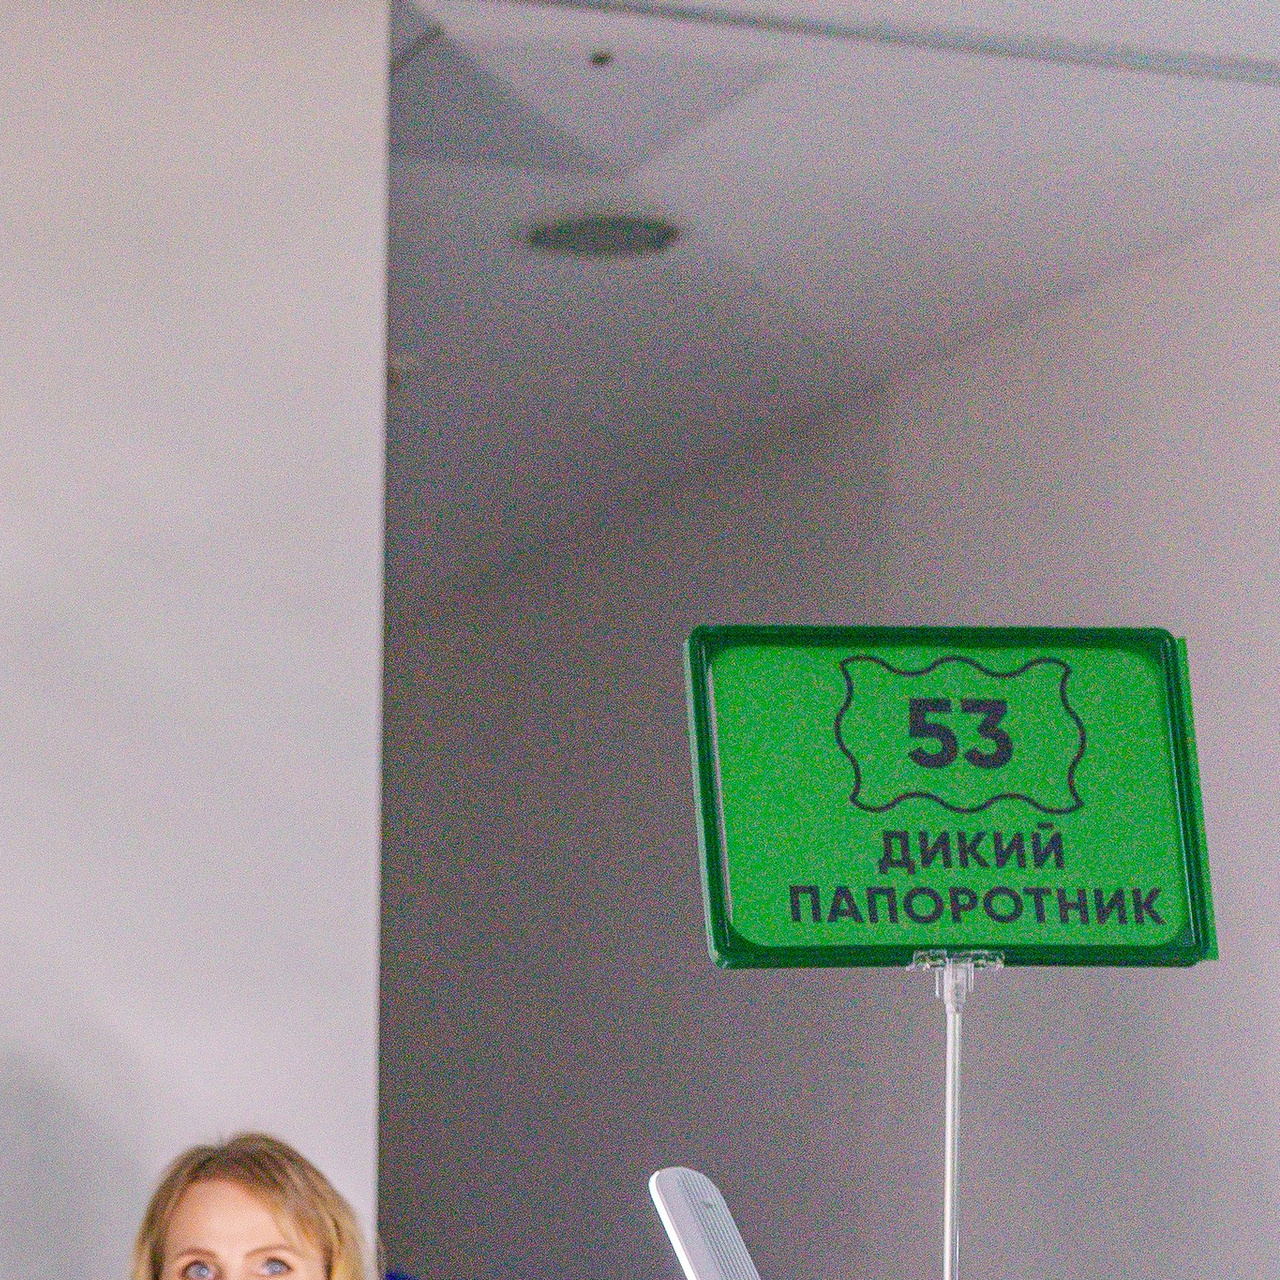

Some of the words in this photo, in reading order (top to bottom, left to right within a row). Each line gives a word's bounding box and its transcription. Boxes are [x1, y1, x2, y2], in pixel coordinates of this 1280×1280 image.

[907, 697, 1014, 770] 53
[877, 822, 1066, 875] ДИКИЙ
[788, 884, 1167, 926] ПАПОРОТНИК
